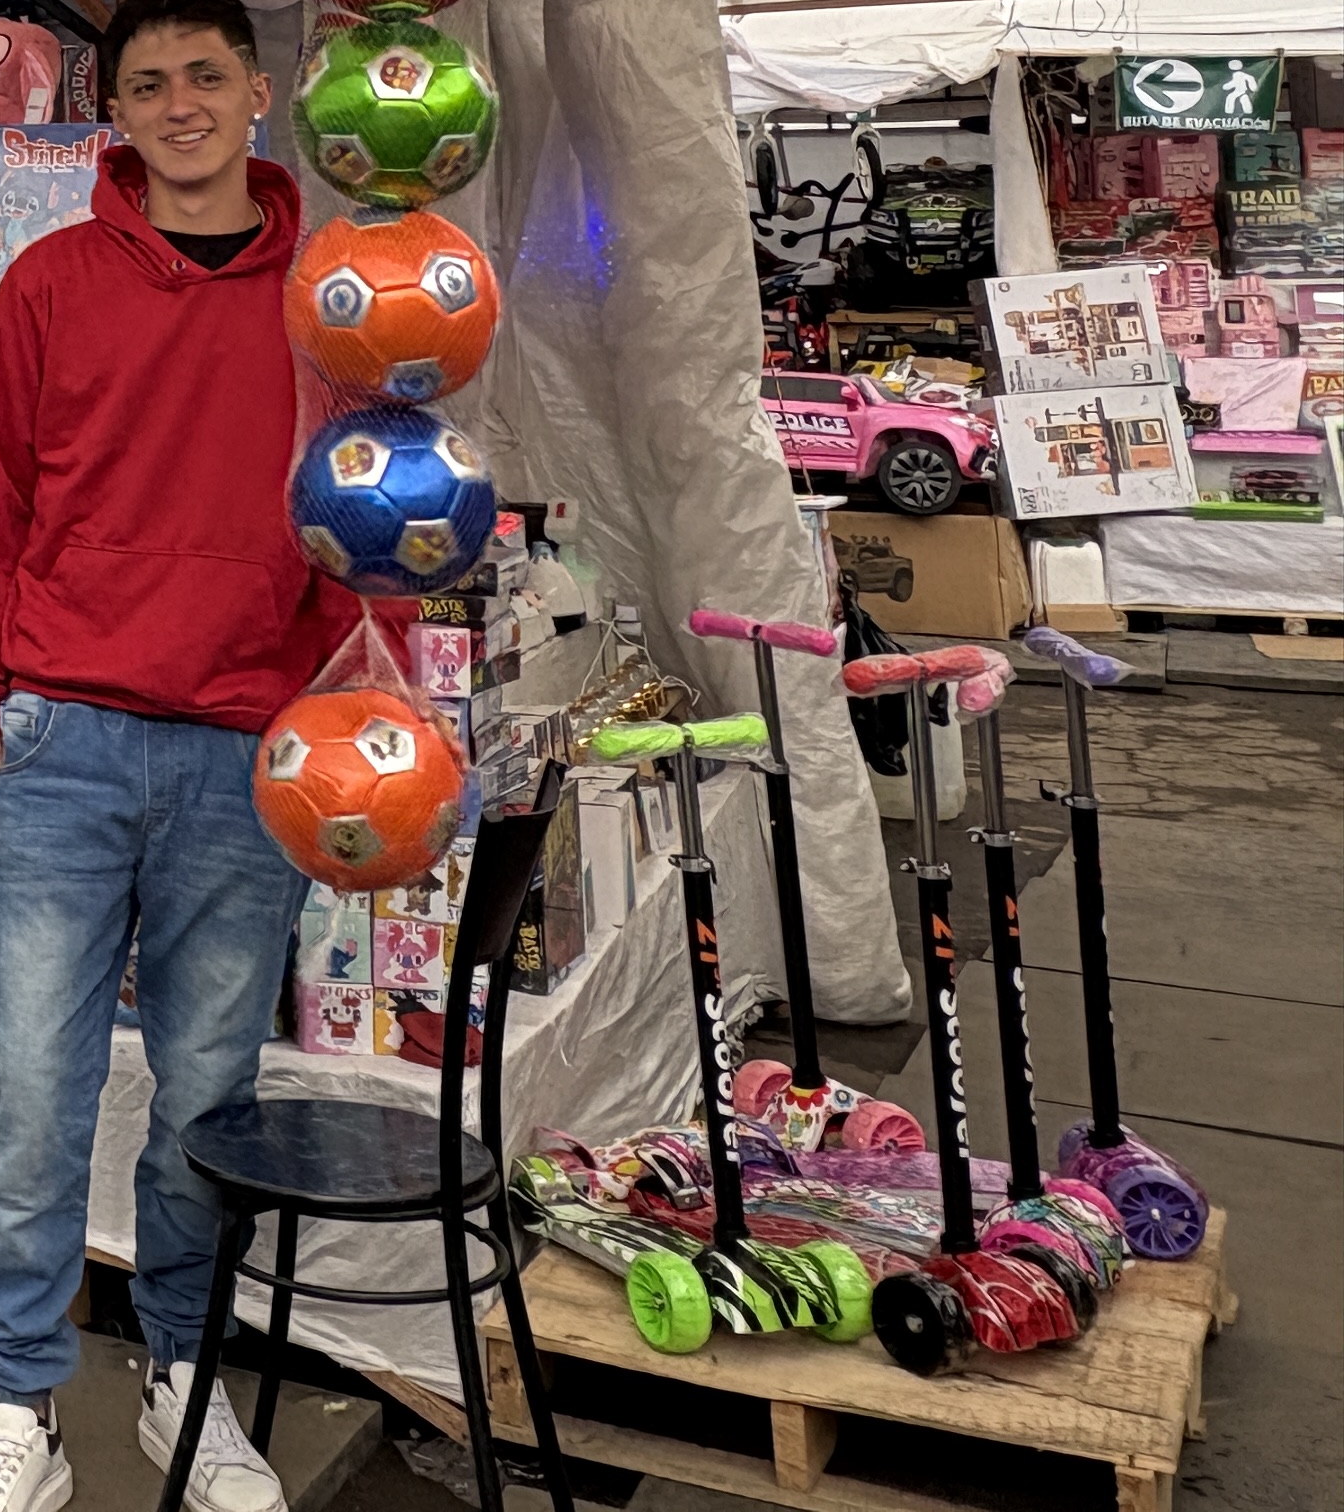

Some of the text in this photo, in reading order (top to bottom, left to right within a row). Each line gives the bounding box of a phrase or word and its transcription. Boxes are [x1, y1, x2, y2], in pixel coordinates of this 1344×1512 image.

[1122, 115, 1158, 128] RUTA
[1161, 116, 1181, 129] DE
[1310, 375, 1344, 395] BA
[767, 411, 852, 435] POLICE
